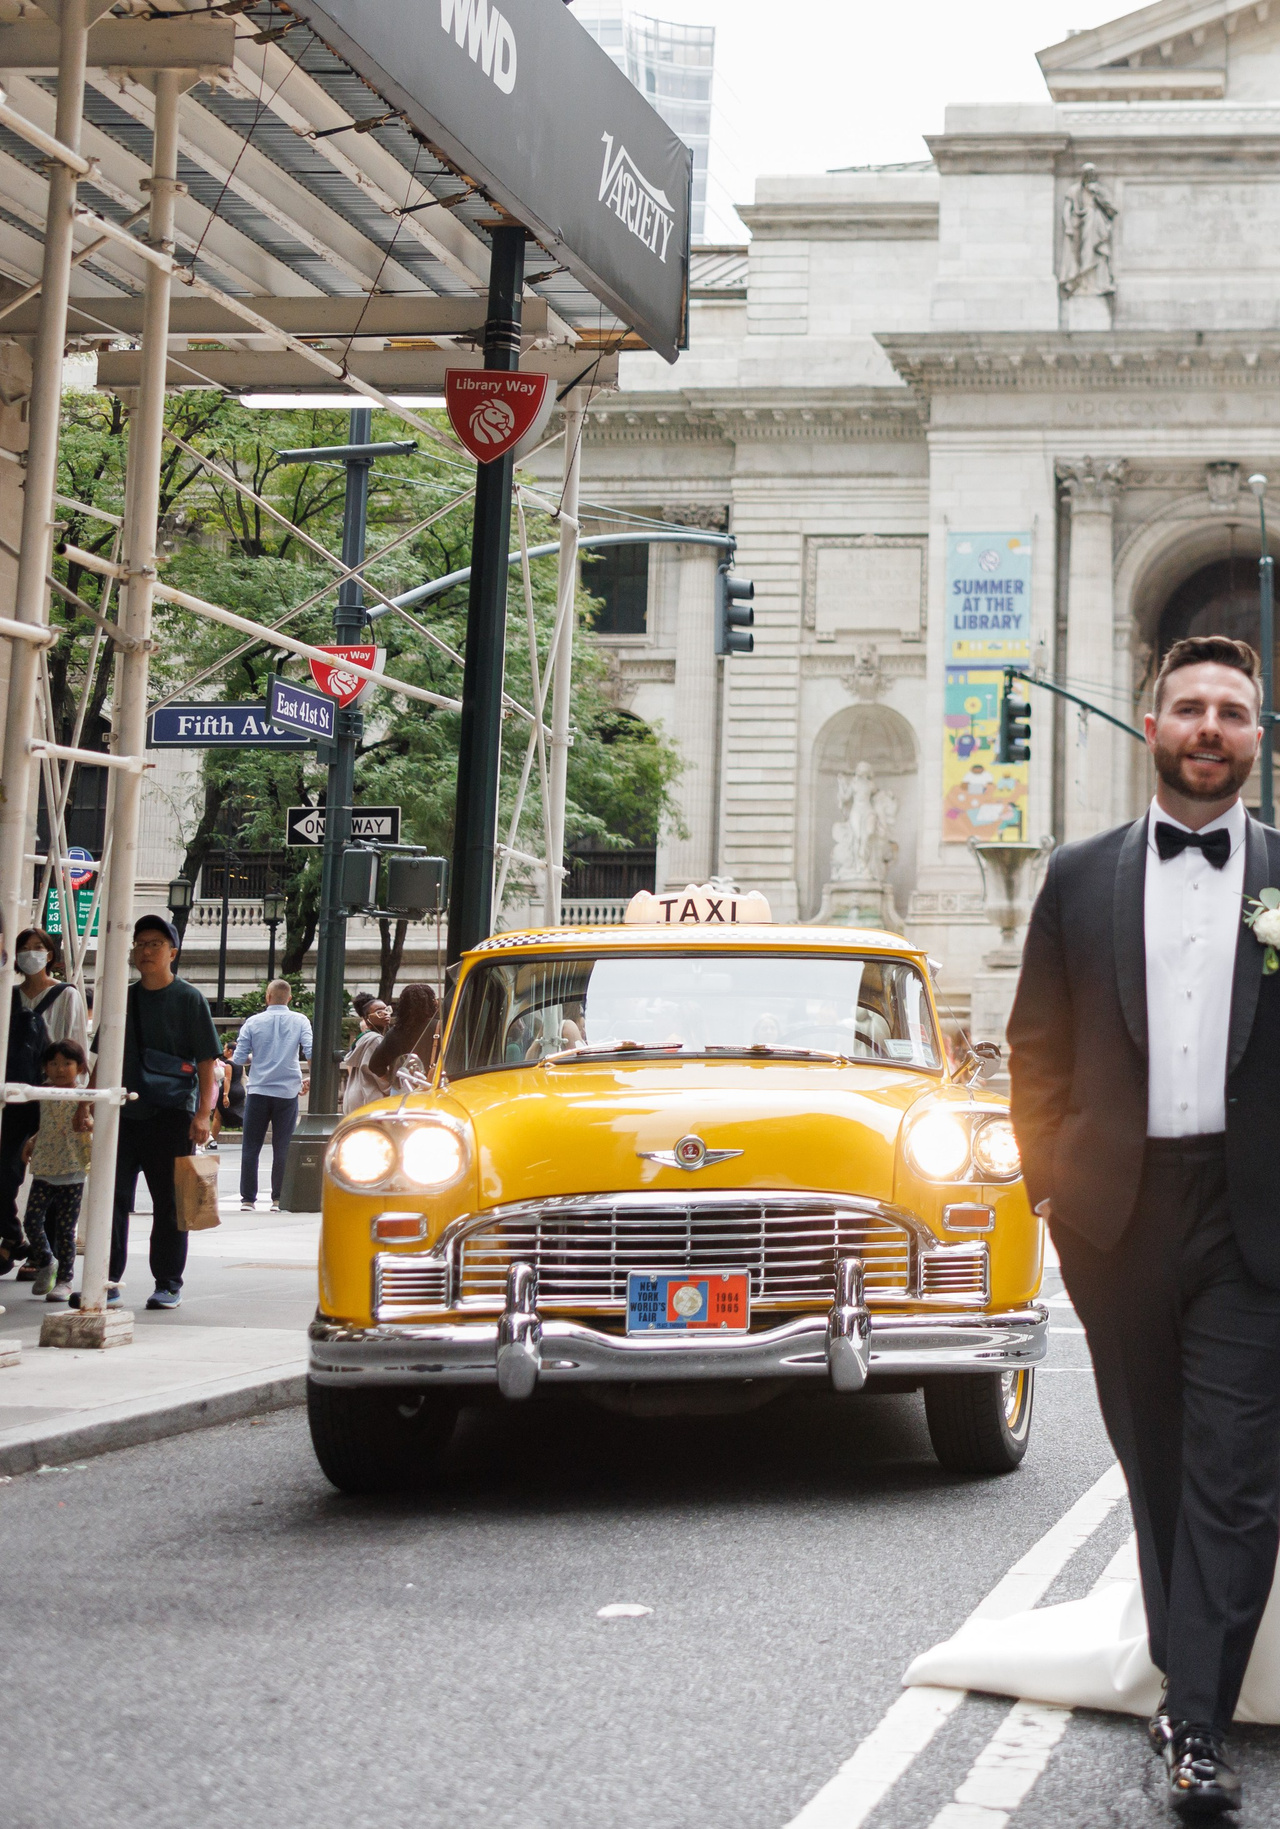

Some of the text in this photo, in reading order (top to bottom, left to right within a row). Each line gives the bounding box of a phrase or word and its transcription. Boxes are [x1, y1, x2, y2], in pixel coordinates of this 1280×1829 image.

[599, 131, 675, 263] VARIETY
[456, 378, 537, 396] Library Way
[953, 579, 1024, 595] SUMMER
[962, 597, 1014, 612] AT THE
[954, 614, 1022, 630] LIBRARY
[350, 651, 371, 661] Way
[277, 692, 330, 730] East 41st St
[177, 715, 286, 736] Fifth Ave
[305, 819, 384, 834] ON WAY
[49, 901, 60, 910] x2
[660, 898, 737, 922] TAXI
[48, 912, 60, 921] x3
[640, 1282, 658, 1291] NEW
[638, 1292, 659, 1301] YORK
[716, 1293, 739, 1302] 1964
[630, 1302, 666, 1311] WORLD'S
[716, 1303, 739, 1312] 1965
[638, 1313, 657, 1322] FAIR
